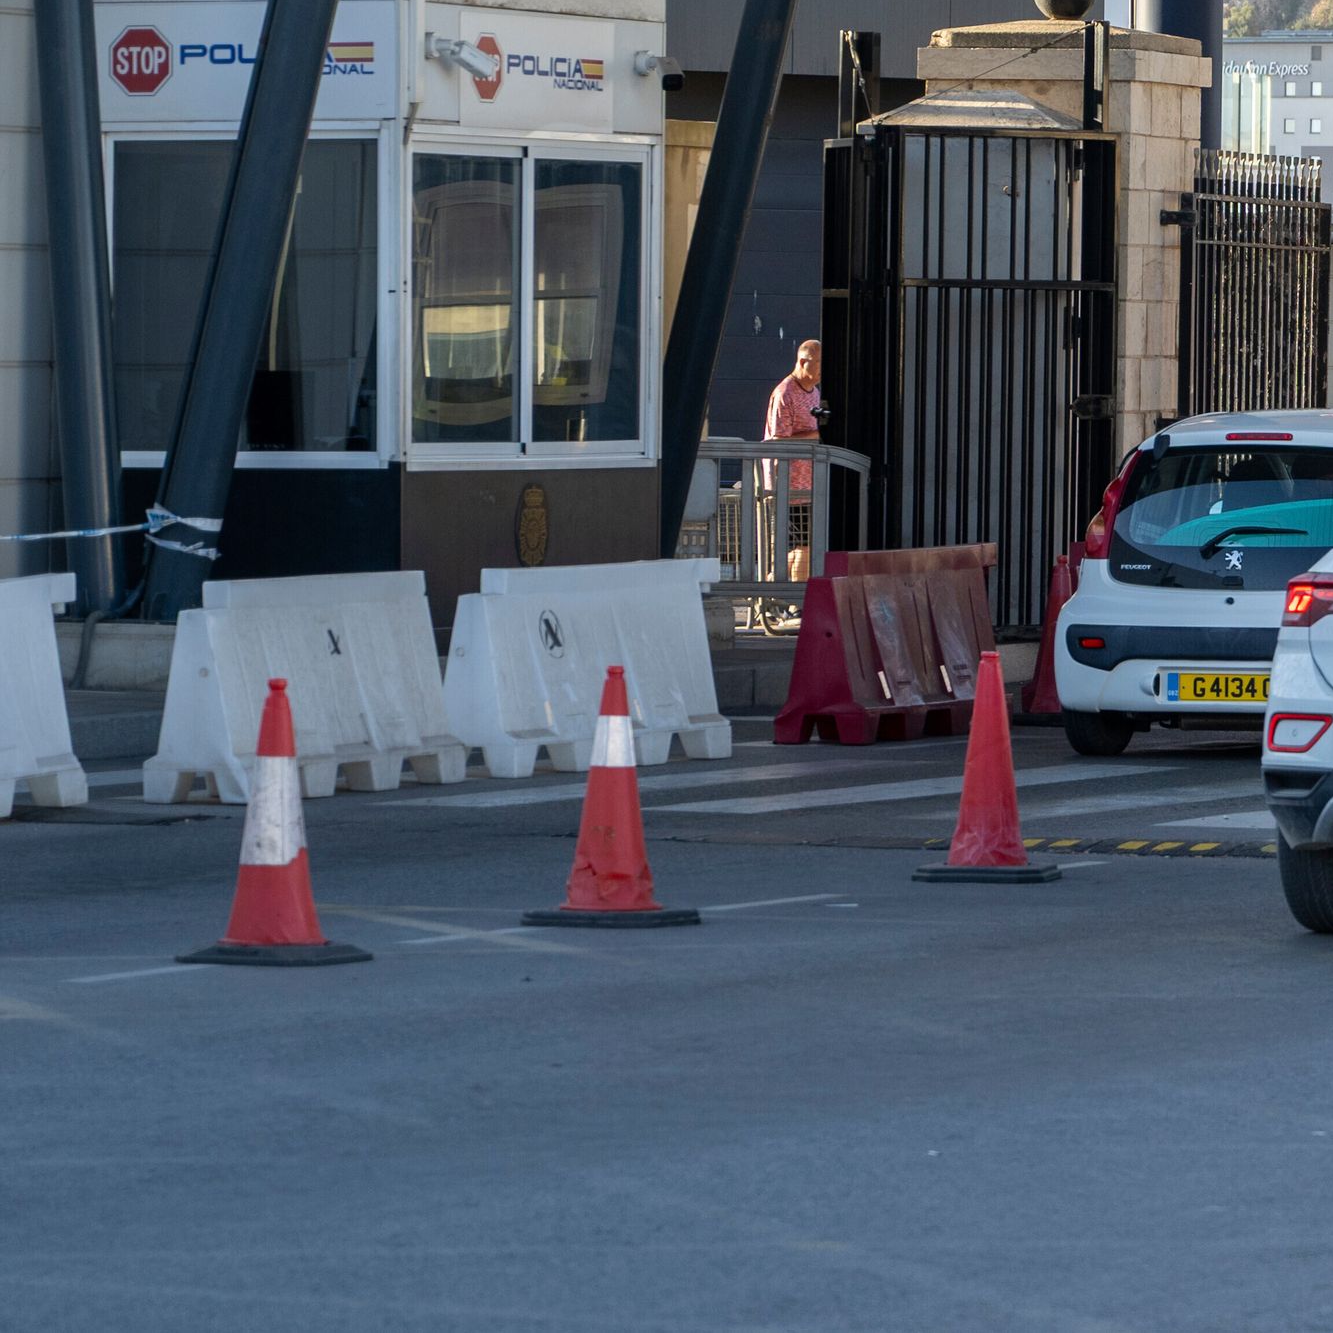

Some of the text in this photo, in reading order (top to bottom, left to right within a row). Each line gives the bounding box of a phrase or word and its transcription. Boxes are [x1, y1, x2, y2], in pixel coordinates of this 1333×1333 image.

[116, 47, 166, 75] STOP
[1269, 62, 1309, 78] Express
[553, 78, 603, 92] NACIONAL
